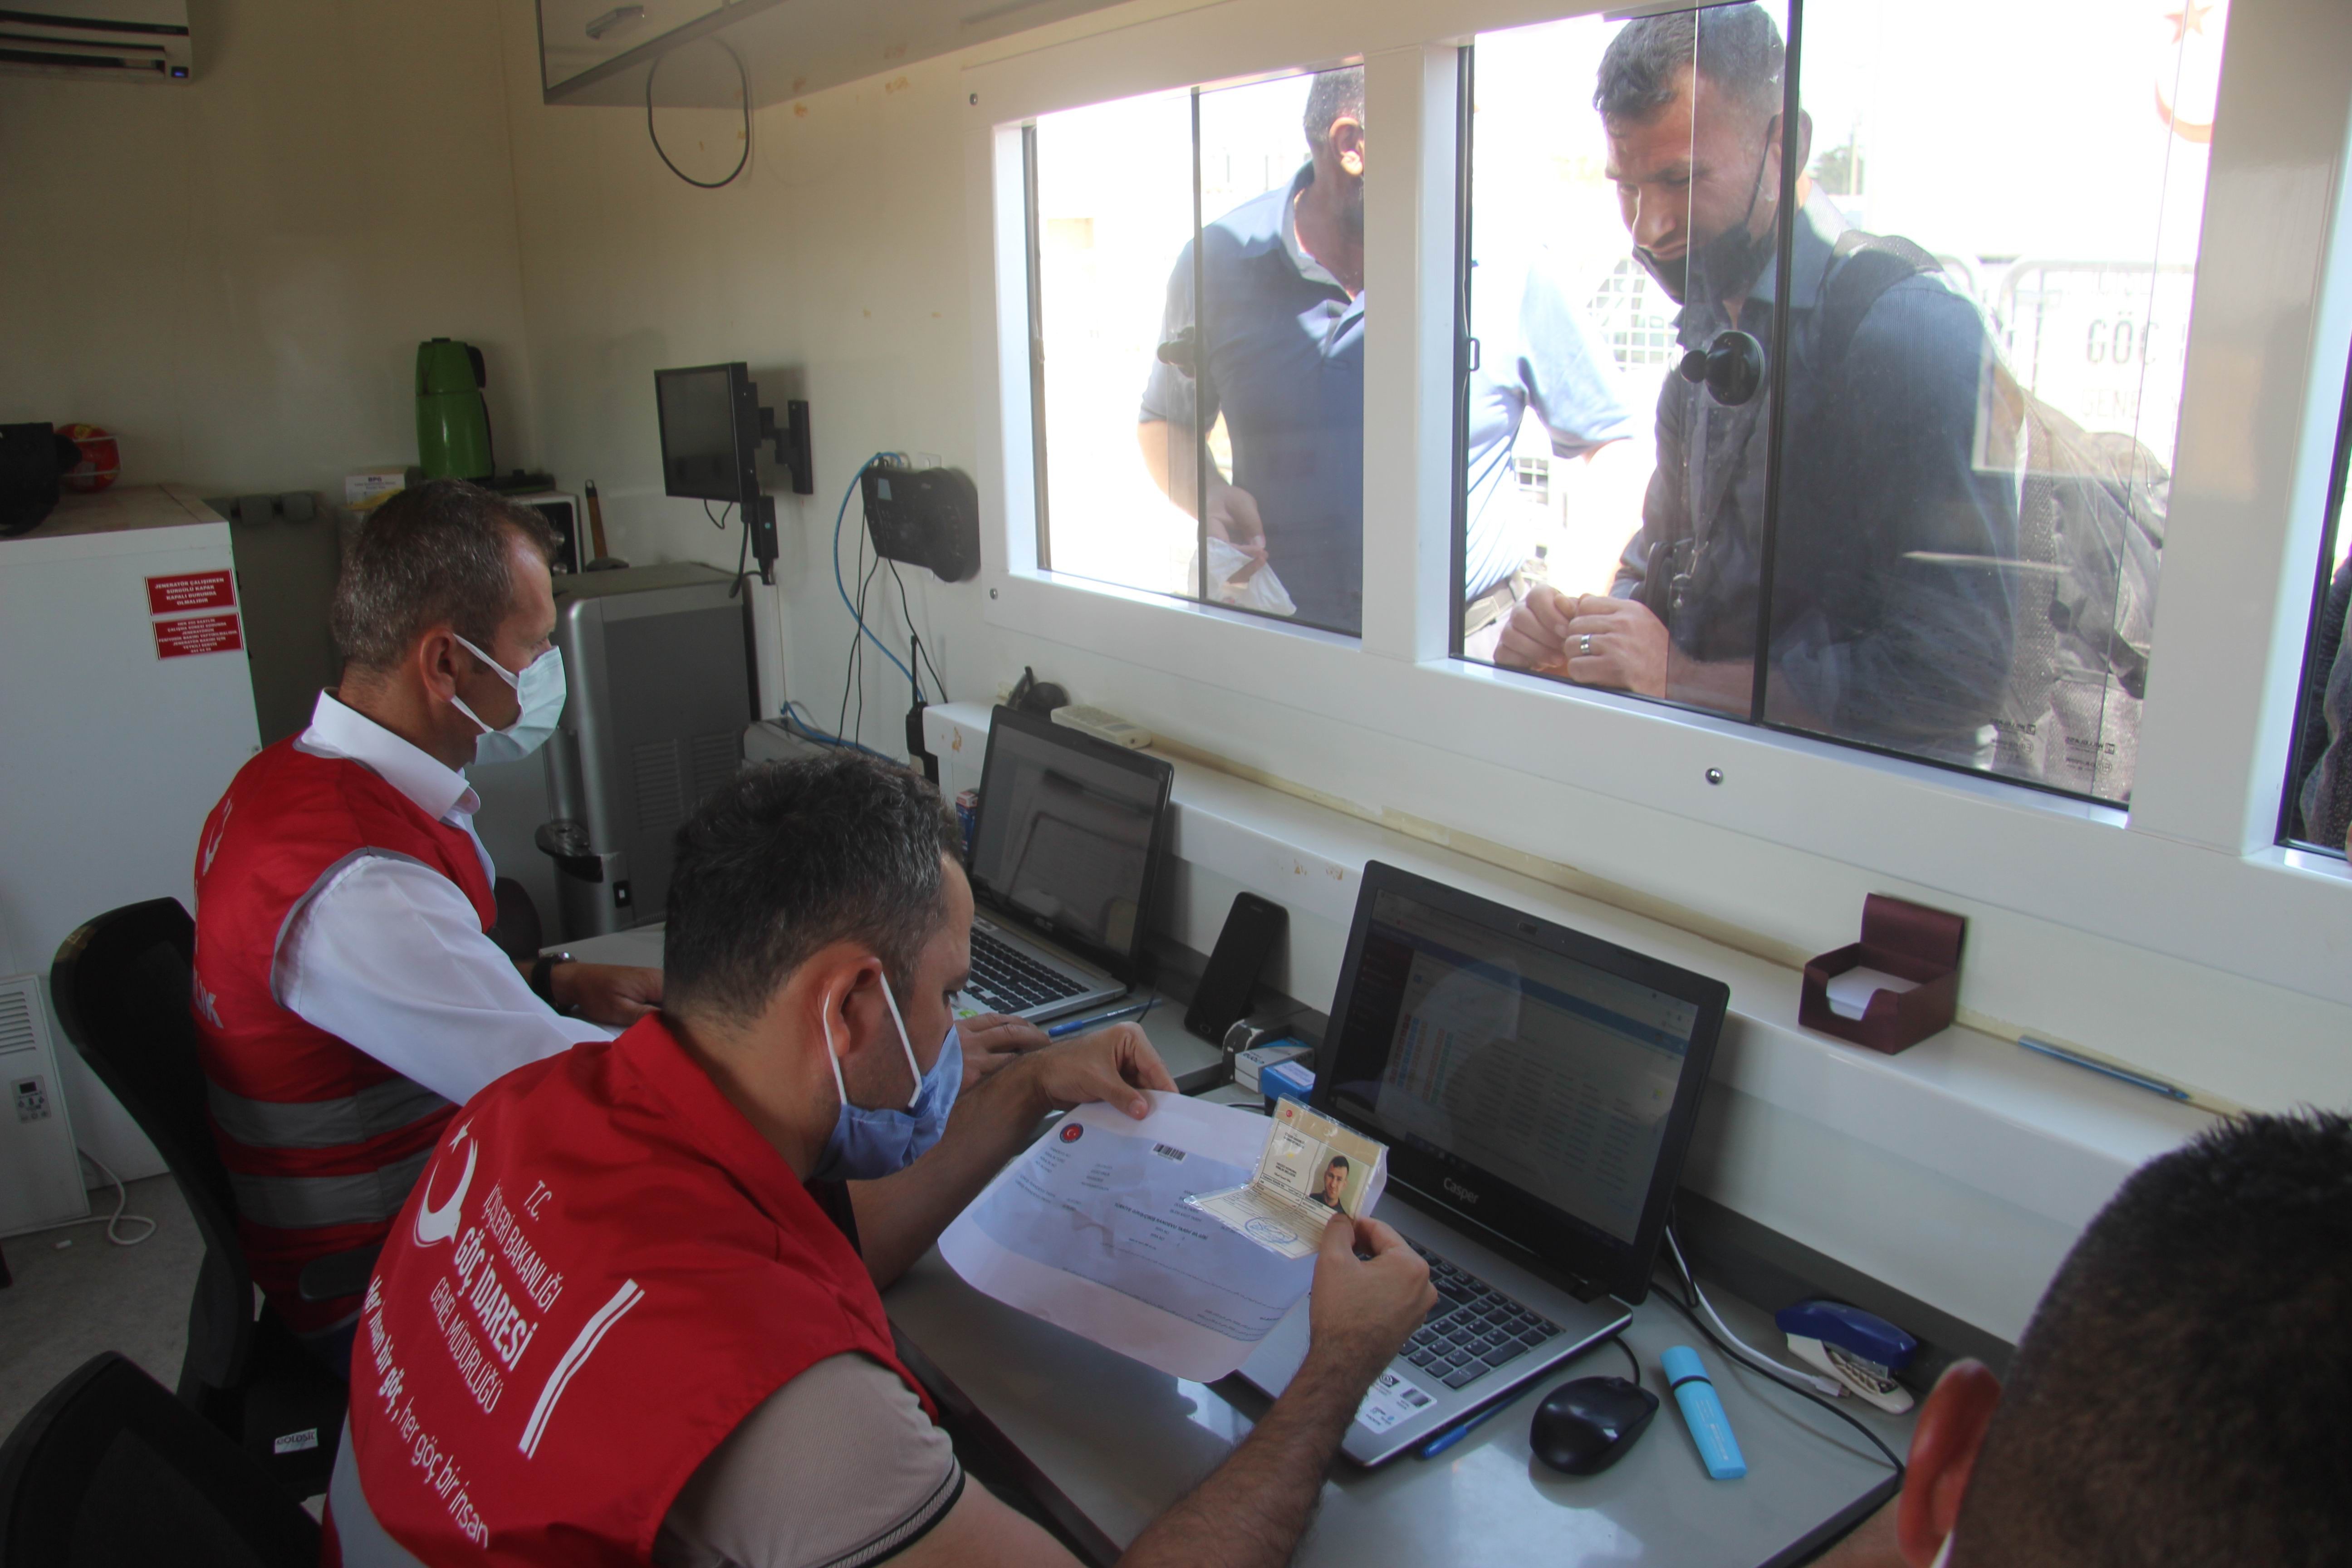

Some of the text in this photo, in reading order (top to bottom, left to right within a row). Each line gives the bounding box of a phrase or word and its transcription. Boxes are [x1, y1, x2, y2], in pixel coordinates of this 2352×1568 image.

[155, 578, 224, 589] JENERATÖR ÇALIŞIRKEN
[1444, 1177, 1479, 1204] Casper
[482, 1179, 563, 1313] İÇİŞLERİ BAKANLIĞI
[365, 1274, 382, 1314] Her
[454, 1227, 539, 1371] GÖÇ İDARESİ
[376, 1334, 394, 1375] bir
[431, 1276, 504, 1414] GENEL MÜDÜRLÜĞÜ
[397, 1396, 420, 1443] her
[412, 1434, 443, 1484] göç
[436, 1455, 461, 1499] bir
[448, 1481, 489, 1548] insan
